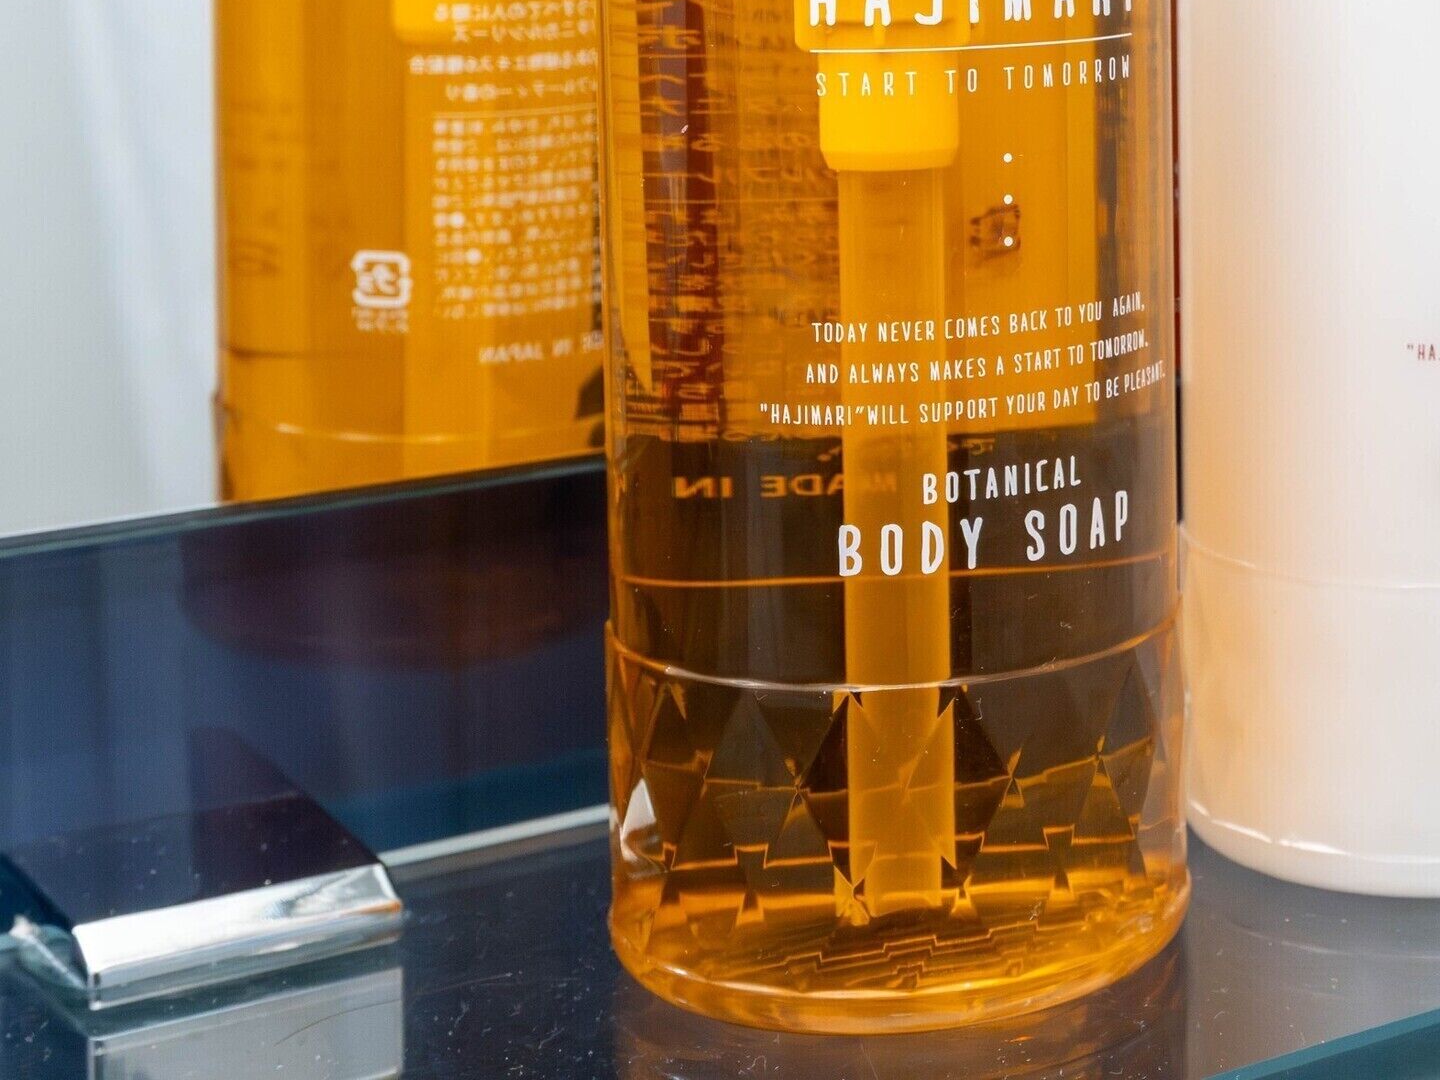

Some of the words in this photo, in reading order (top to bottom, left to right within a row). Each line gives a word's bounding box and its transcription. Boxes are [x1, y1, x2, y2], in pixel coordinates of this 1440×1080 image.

[816, 70, 918, 98] START
[945, 68, 978, 94] TO
[1003, 54, 1130, 92] TOMORROW
[812, 321, 868, 344] TODAY
[878, 317, 935, 343] NEVER
[945, 314, 1000, 341] COMES
[1009, 308, 1048, 333] BACK
[1055, 306, 1072, 328] TO
[1079, 301, 1102, 324] YOU
[1112, 290, 1145, 318] AGAIN,
[806, 363, 839, 385] AND
[848, 362, 919, 385] ALWAYS
[929, 357, 986, 381] MAKES
[996, 354, 1005, 376] A
[1014, 348, 1061, 373] START
[1067, 344, 1084, 366] TO
[1090, 328, 1149, 362] TOMORROW.
[919, 398, 997, 423] SUPPORT
[1007, 393, 1046, 414] YOUR
[1053, 386, 1078, 409] DAY
[1085, 381, 1100, 404] TO
[1106, 377, 1119, 399] BE
[923, 454, 1082, 505] BOTANICAL
[838, 516, 984, 578] BODY
[1025, 490, 1129, 562] SOAP
